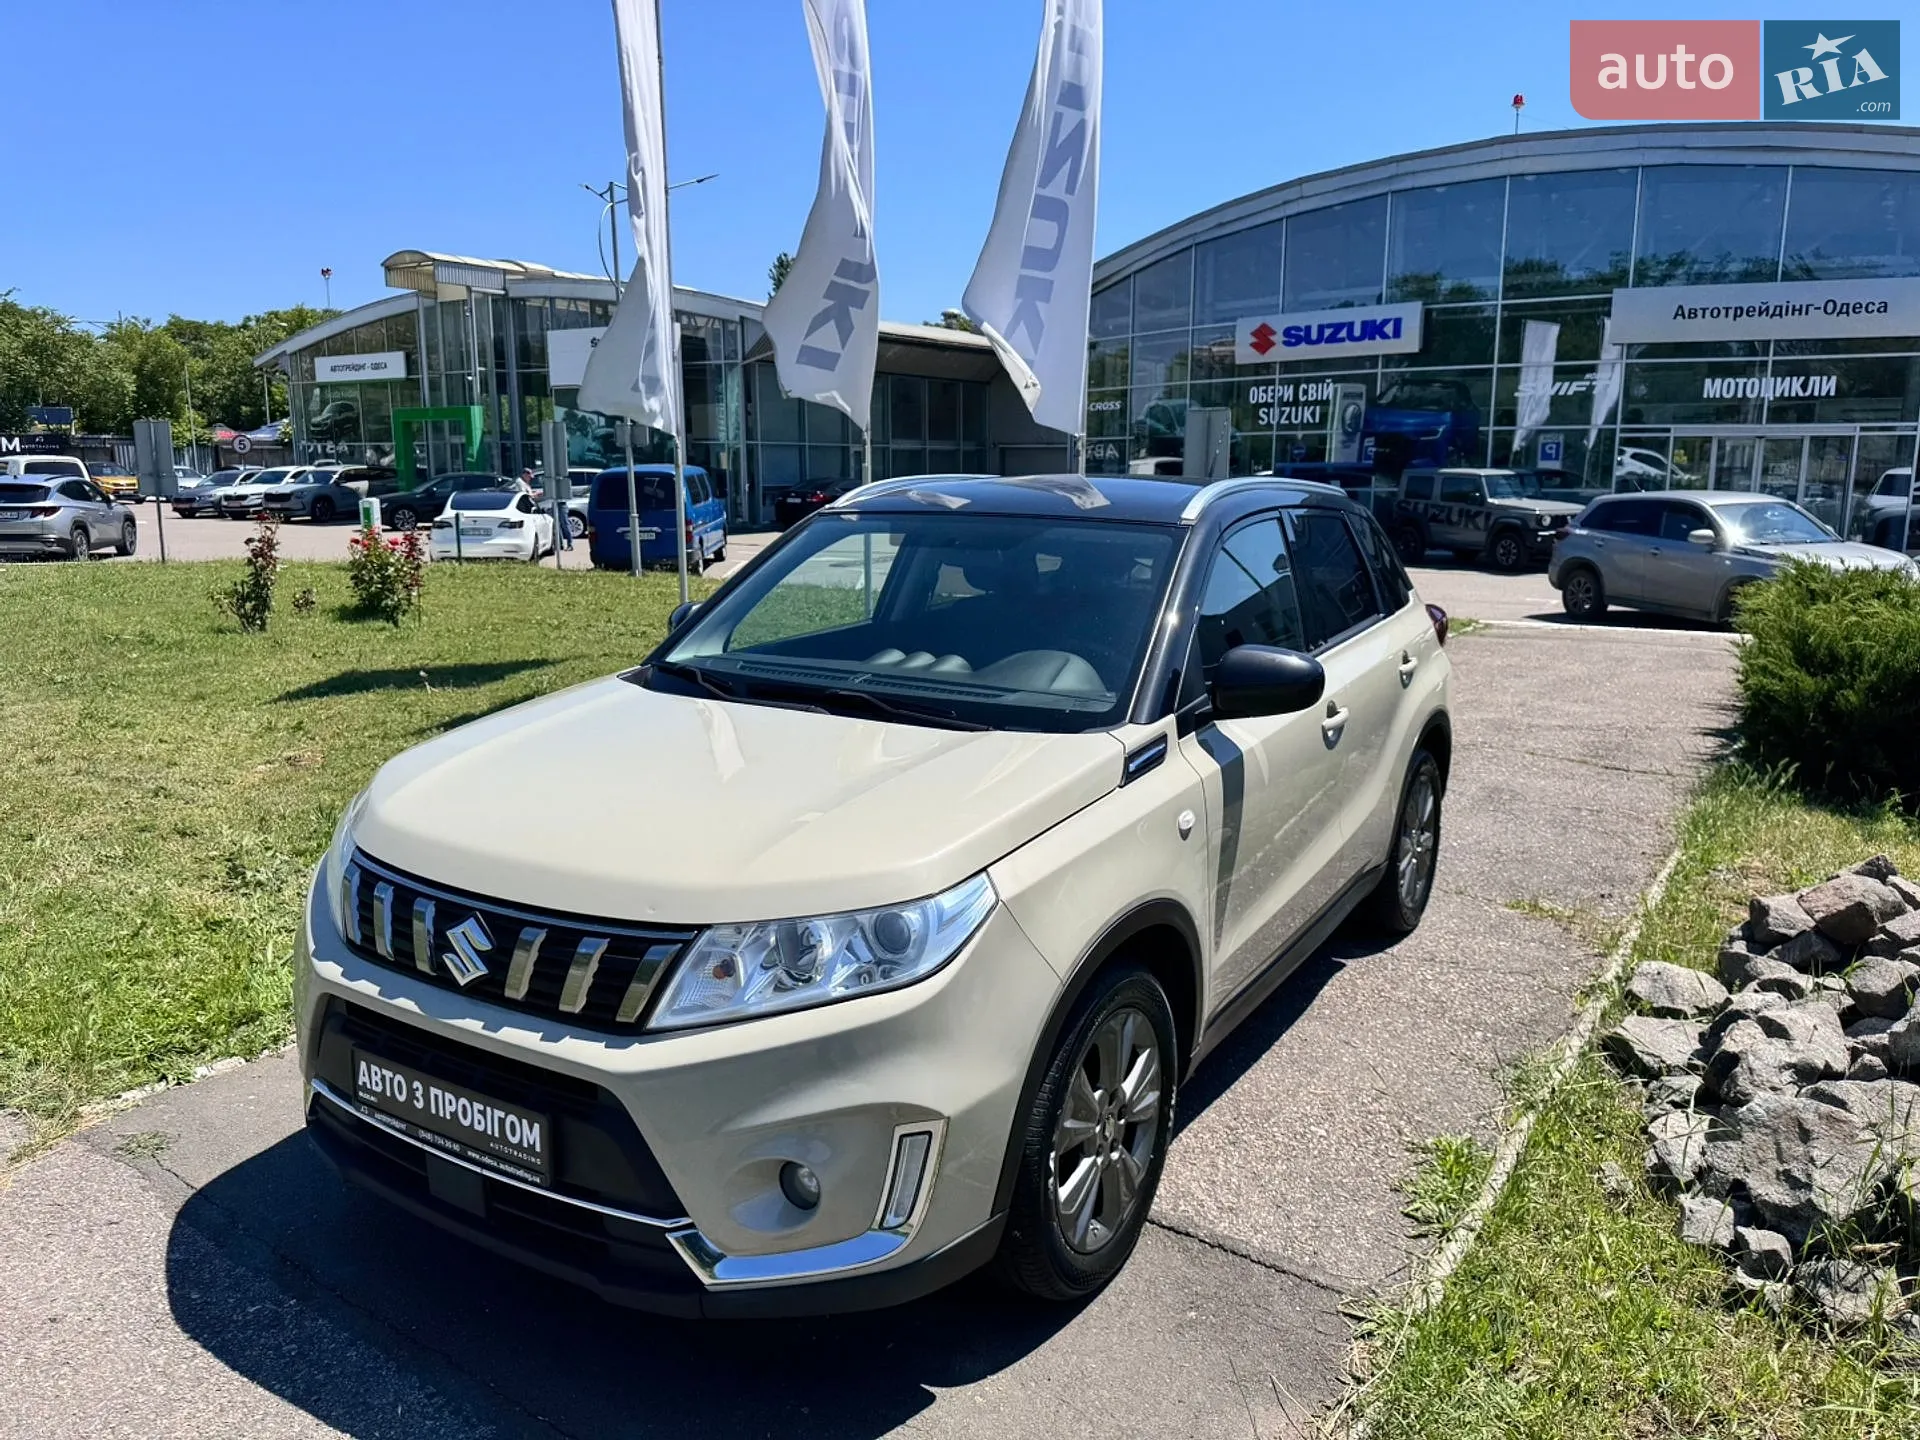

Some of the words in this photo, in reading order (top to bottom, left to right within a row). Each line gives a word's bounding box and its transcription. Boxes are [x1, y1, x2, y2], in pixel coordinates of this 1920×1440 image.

[1672, 298, 1889, 322] Автотрейдінг-Одеса
[1282, 317, 1402, 348] SUZUKI
[1249, 383, 1295, 405] ОБЕРИ
[1299, 378, 1335, 404] СВІЙ
[1703, 375, 1837, 400] МОТОЦИКЛИ
[1258, 405, 1321, 426] SUZUKI
[238, 438, 247, 451] 5
[1396, 498, 1493, 532] SUZUKI
[358, 1060, 408, 1103] АВТО
[429, 1086, 542, 1153] ПРОБІГОМ
